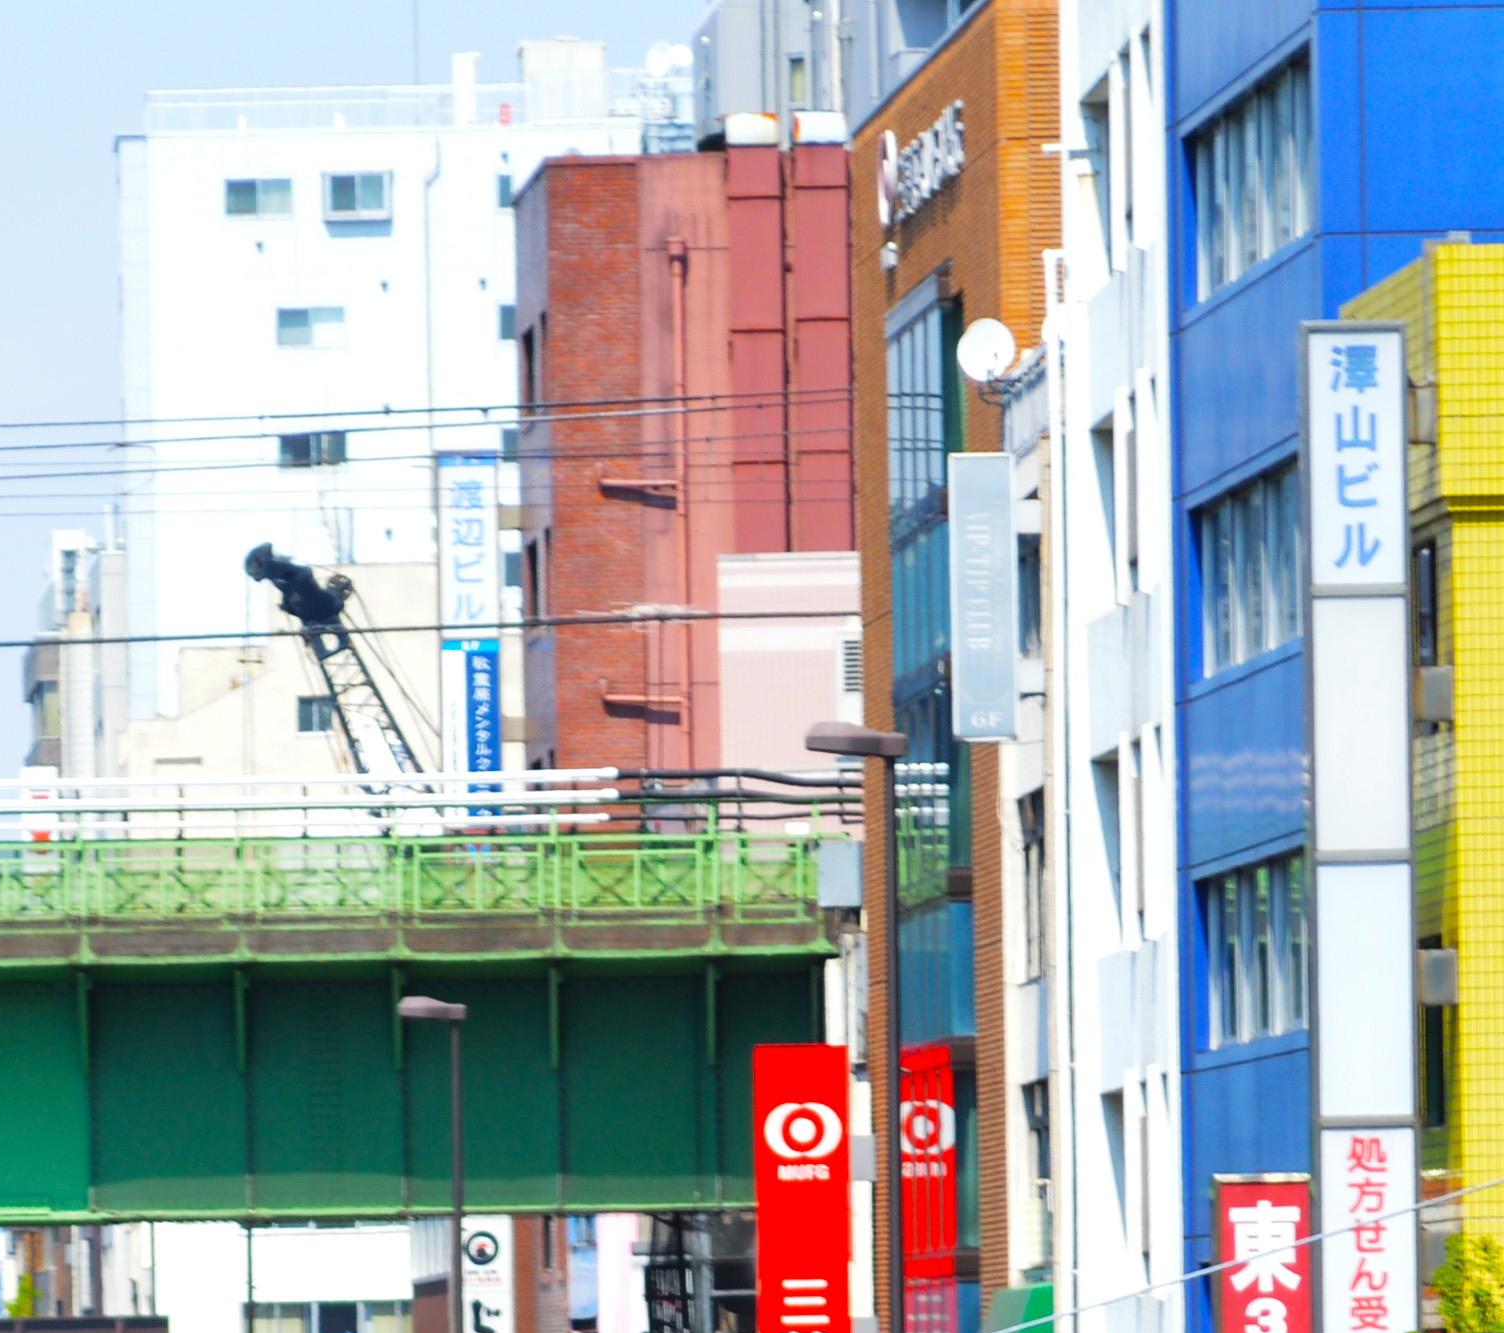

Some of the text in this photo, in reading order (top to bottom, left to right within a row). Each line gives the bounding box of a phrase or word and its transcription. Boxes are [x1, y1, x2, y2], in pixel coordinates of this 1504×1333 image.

[1330, 344, 1382, 568] 澤山ビル
[449, 478, 486, 622] 渡辺ビル
[777, 1163, 830, 1181] MUFG
